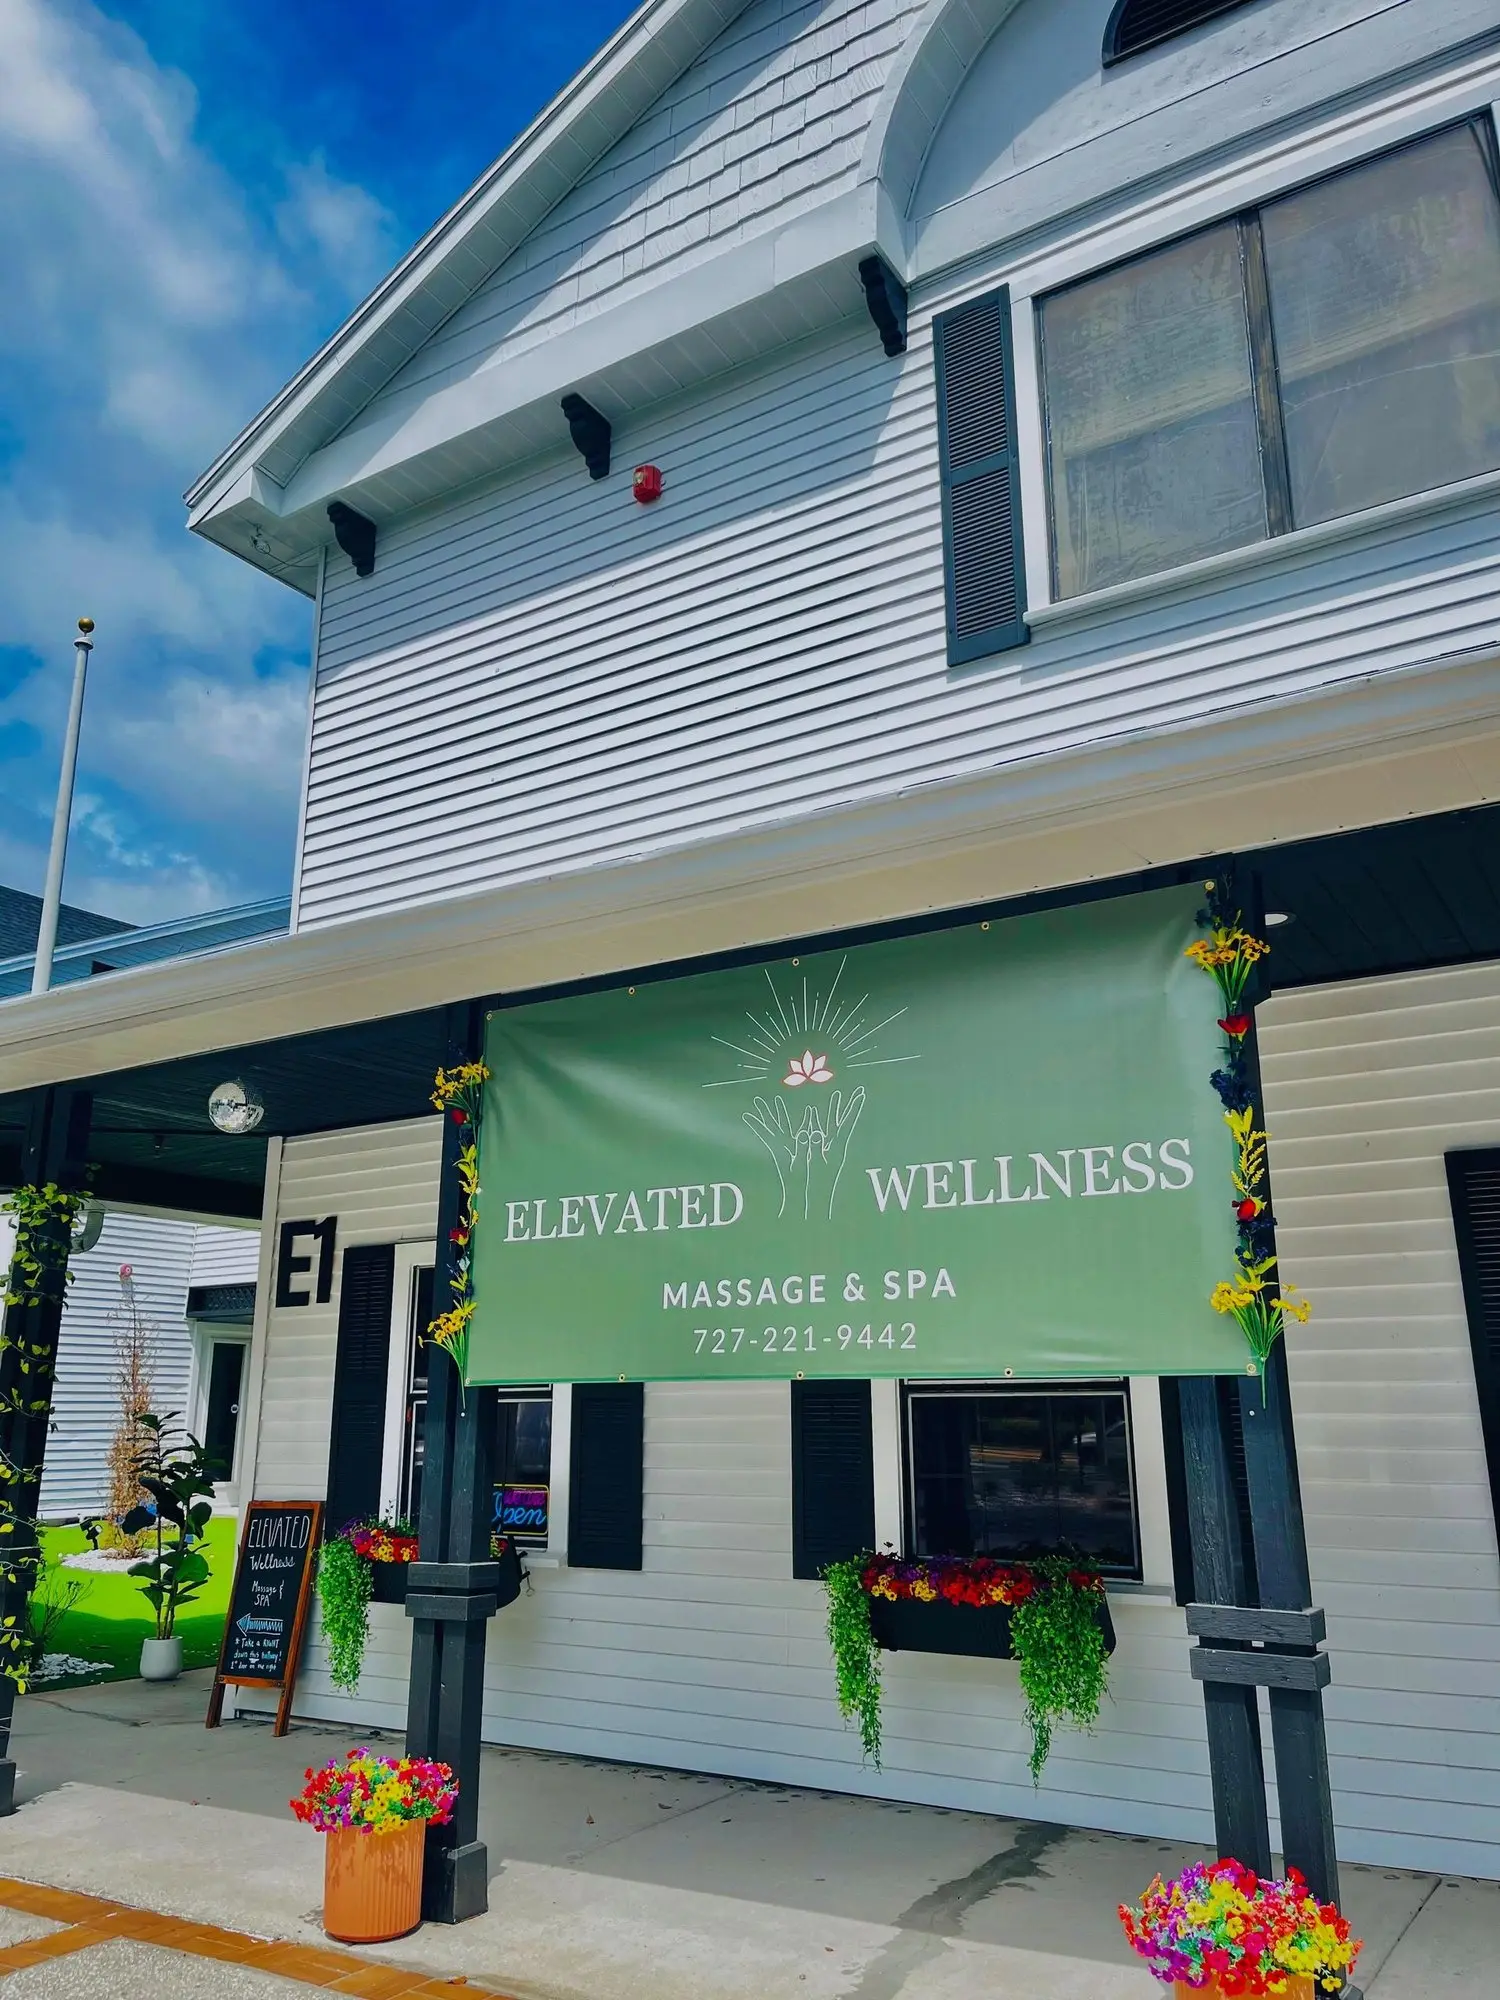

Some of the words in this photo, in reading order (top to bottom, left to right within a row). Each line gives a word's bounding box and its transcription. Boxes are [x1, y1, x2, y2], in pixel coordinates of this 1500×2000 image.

[503, 1182, 744, 1242] ELEVATED
[866, 1138, 1194, 1213] WELLNESS
[276, 1216, 337, 1308] E1
[663, 1275, 826, 1309] MASSAGE
[843, 1272, 866, 1302] &
[884, 1268, 956, 1300] SPA
[693, 1322, 916, 1354] 727-221-9442
[248, 1515, 310, 1548] ELEVATED
[250, 1553, 295, 1570] Wellness
[252, 1580, 277, 1595] Massage
[254, 1594, 270, 1607] SPA
